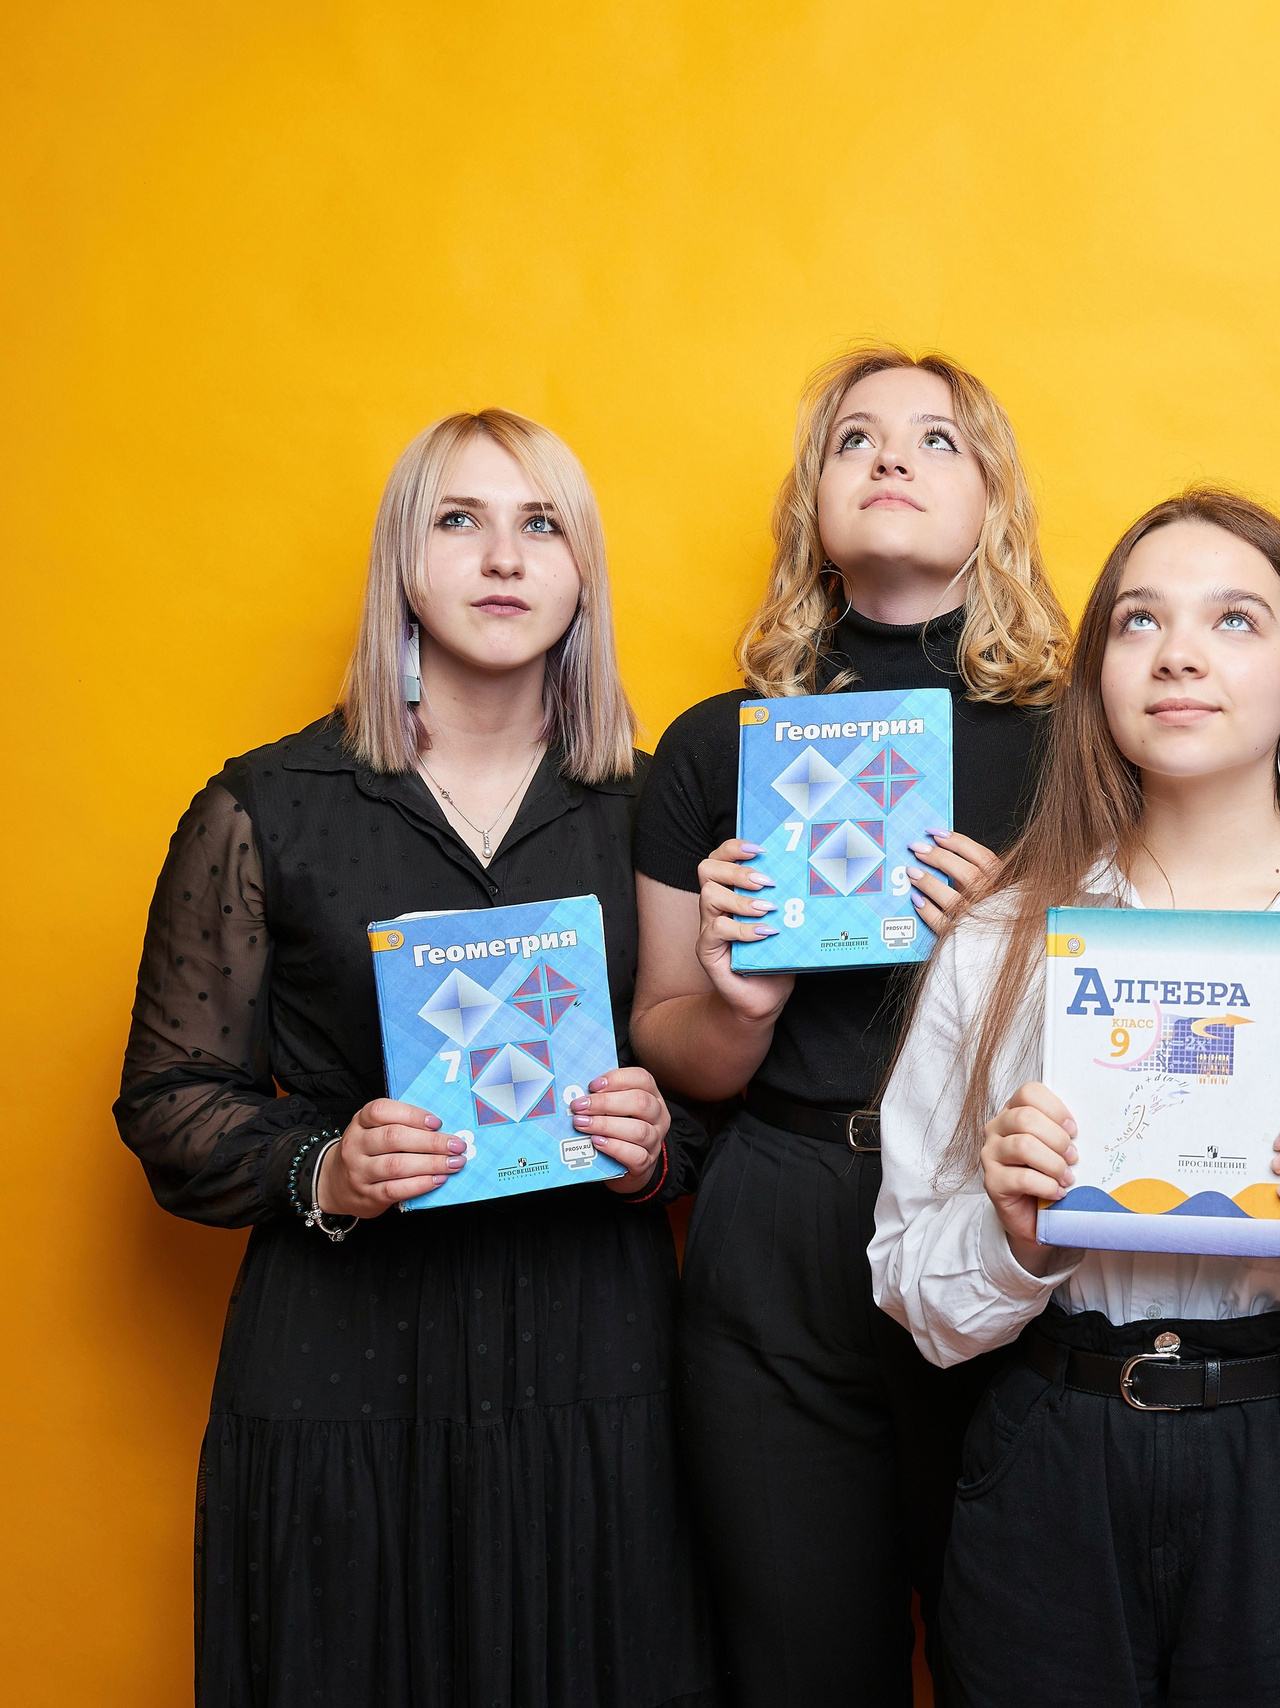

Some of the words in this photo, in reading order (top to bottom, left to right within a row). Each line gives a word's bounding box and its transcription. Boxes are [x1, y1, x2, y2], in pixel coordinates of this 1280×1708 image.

[774, 718, 924, 742] Геометрия
[784, 822, 804, 851] 7
[890, 866, 912, 896] 9
[783, 898, 805, 928] 8
[413, 929, 578, 967] Геометрия
[820, 940, 869, 948] ПРОСВЕЩЕНИЕ
[1112, 1018, 1154, 1030] КЛАСС
[1110, 1028, 1131, 1058] 9
[439, 1050, 462, 1083] 7
[565, 1143, 592, 1153] PROSV.RU
[497, 1164, 550, 1178] ПРОСВЕЩЕНИЕ
[1178, 1159, 1248, 1170] ПРОСВЕЩЕНИЕ
